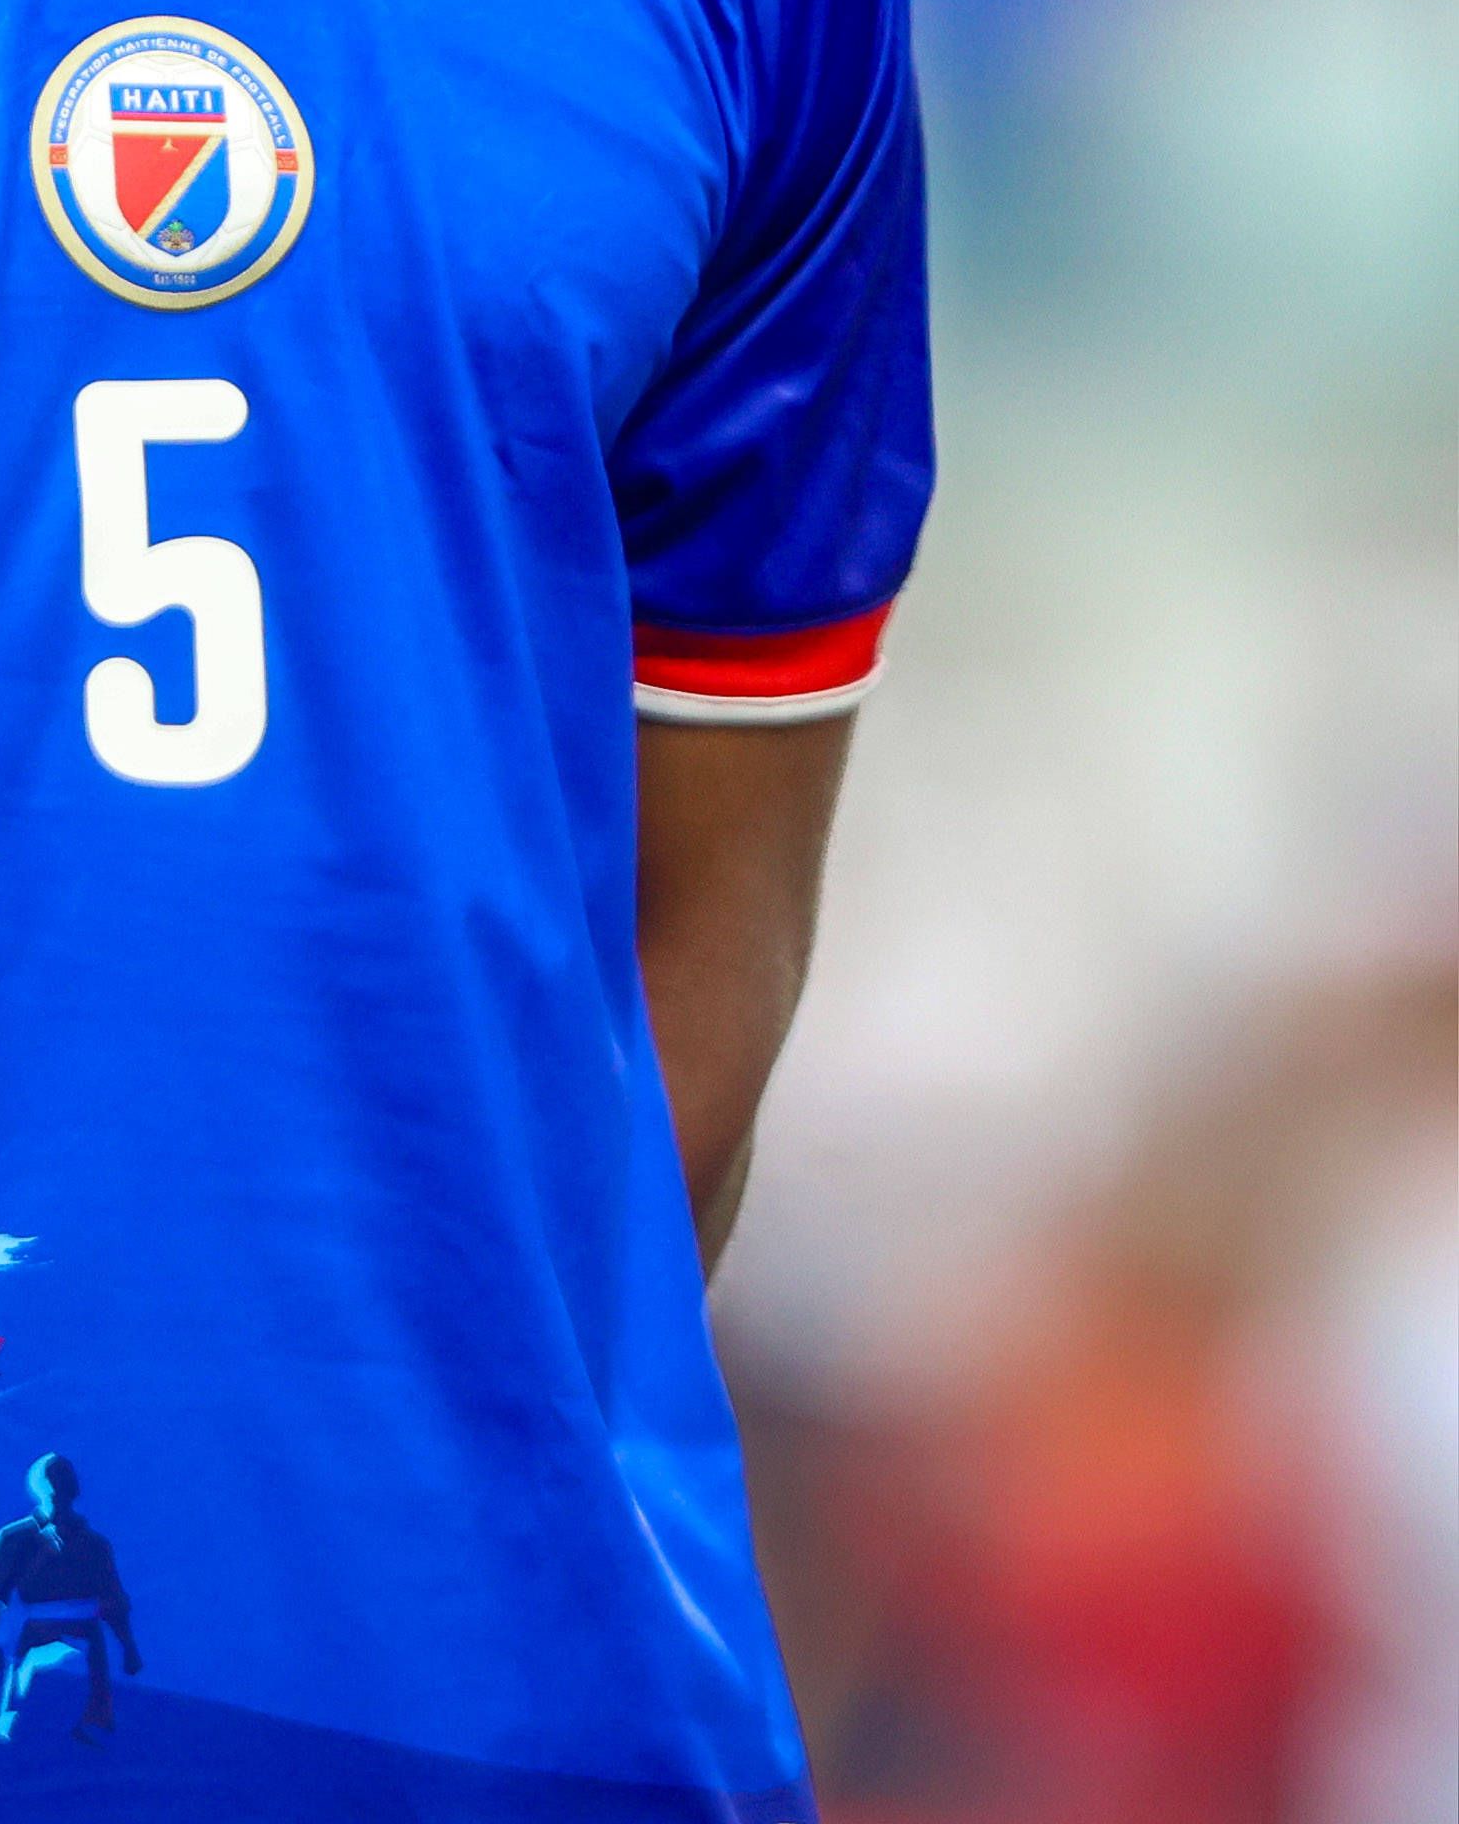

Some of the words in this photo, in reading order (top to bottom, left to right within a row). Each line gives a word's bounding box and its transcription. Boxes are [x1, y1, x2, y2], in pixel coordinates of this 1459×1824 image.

[123, 88, 213, 110] HAITI
[207, 49, 228, 67] DE
[231, 65, 287, 145] FOOTBALL
[74, 379, 267, 786] 5
